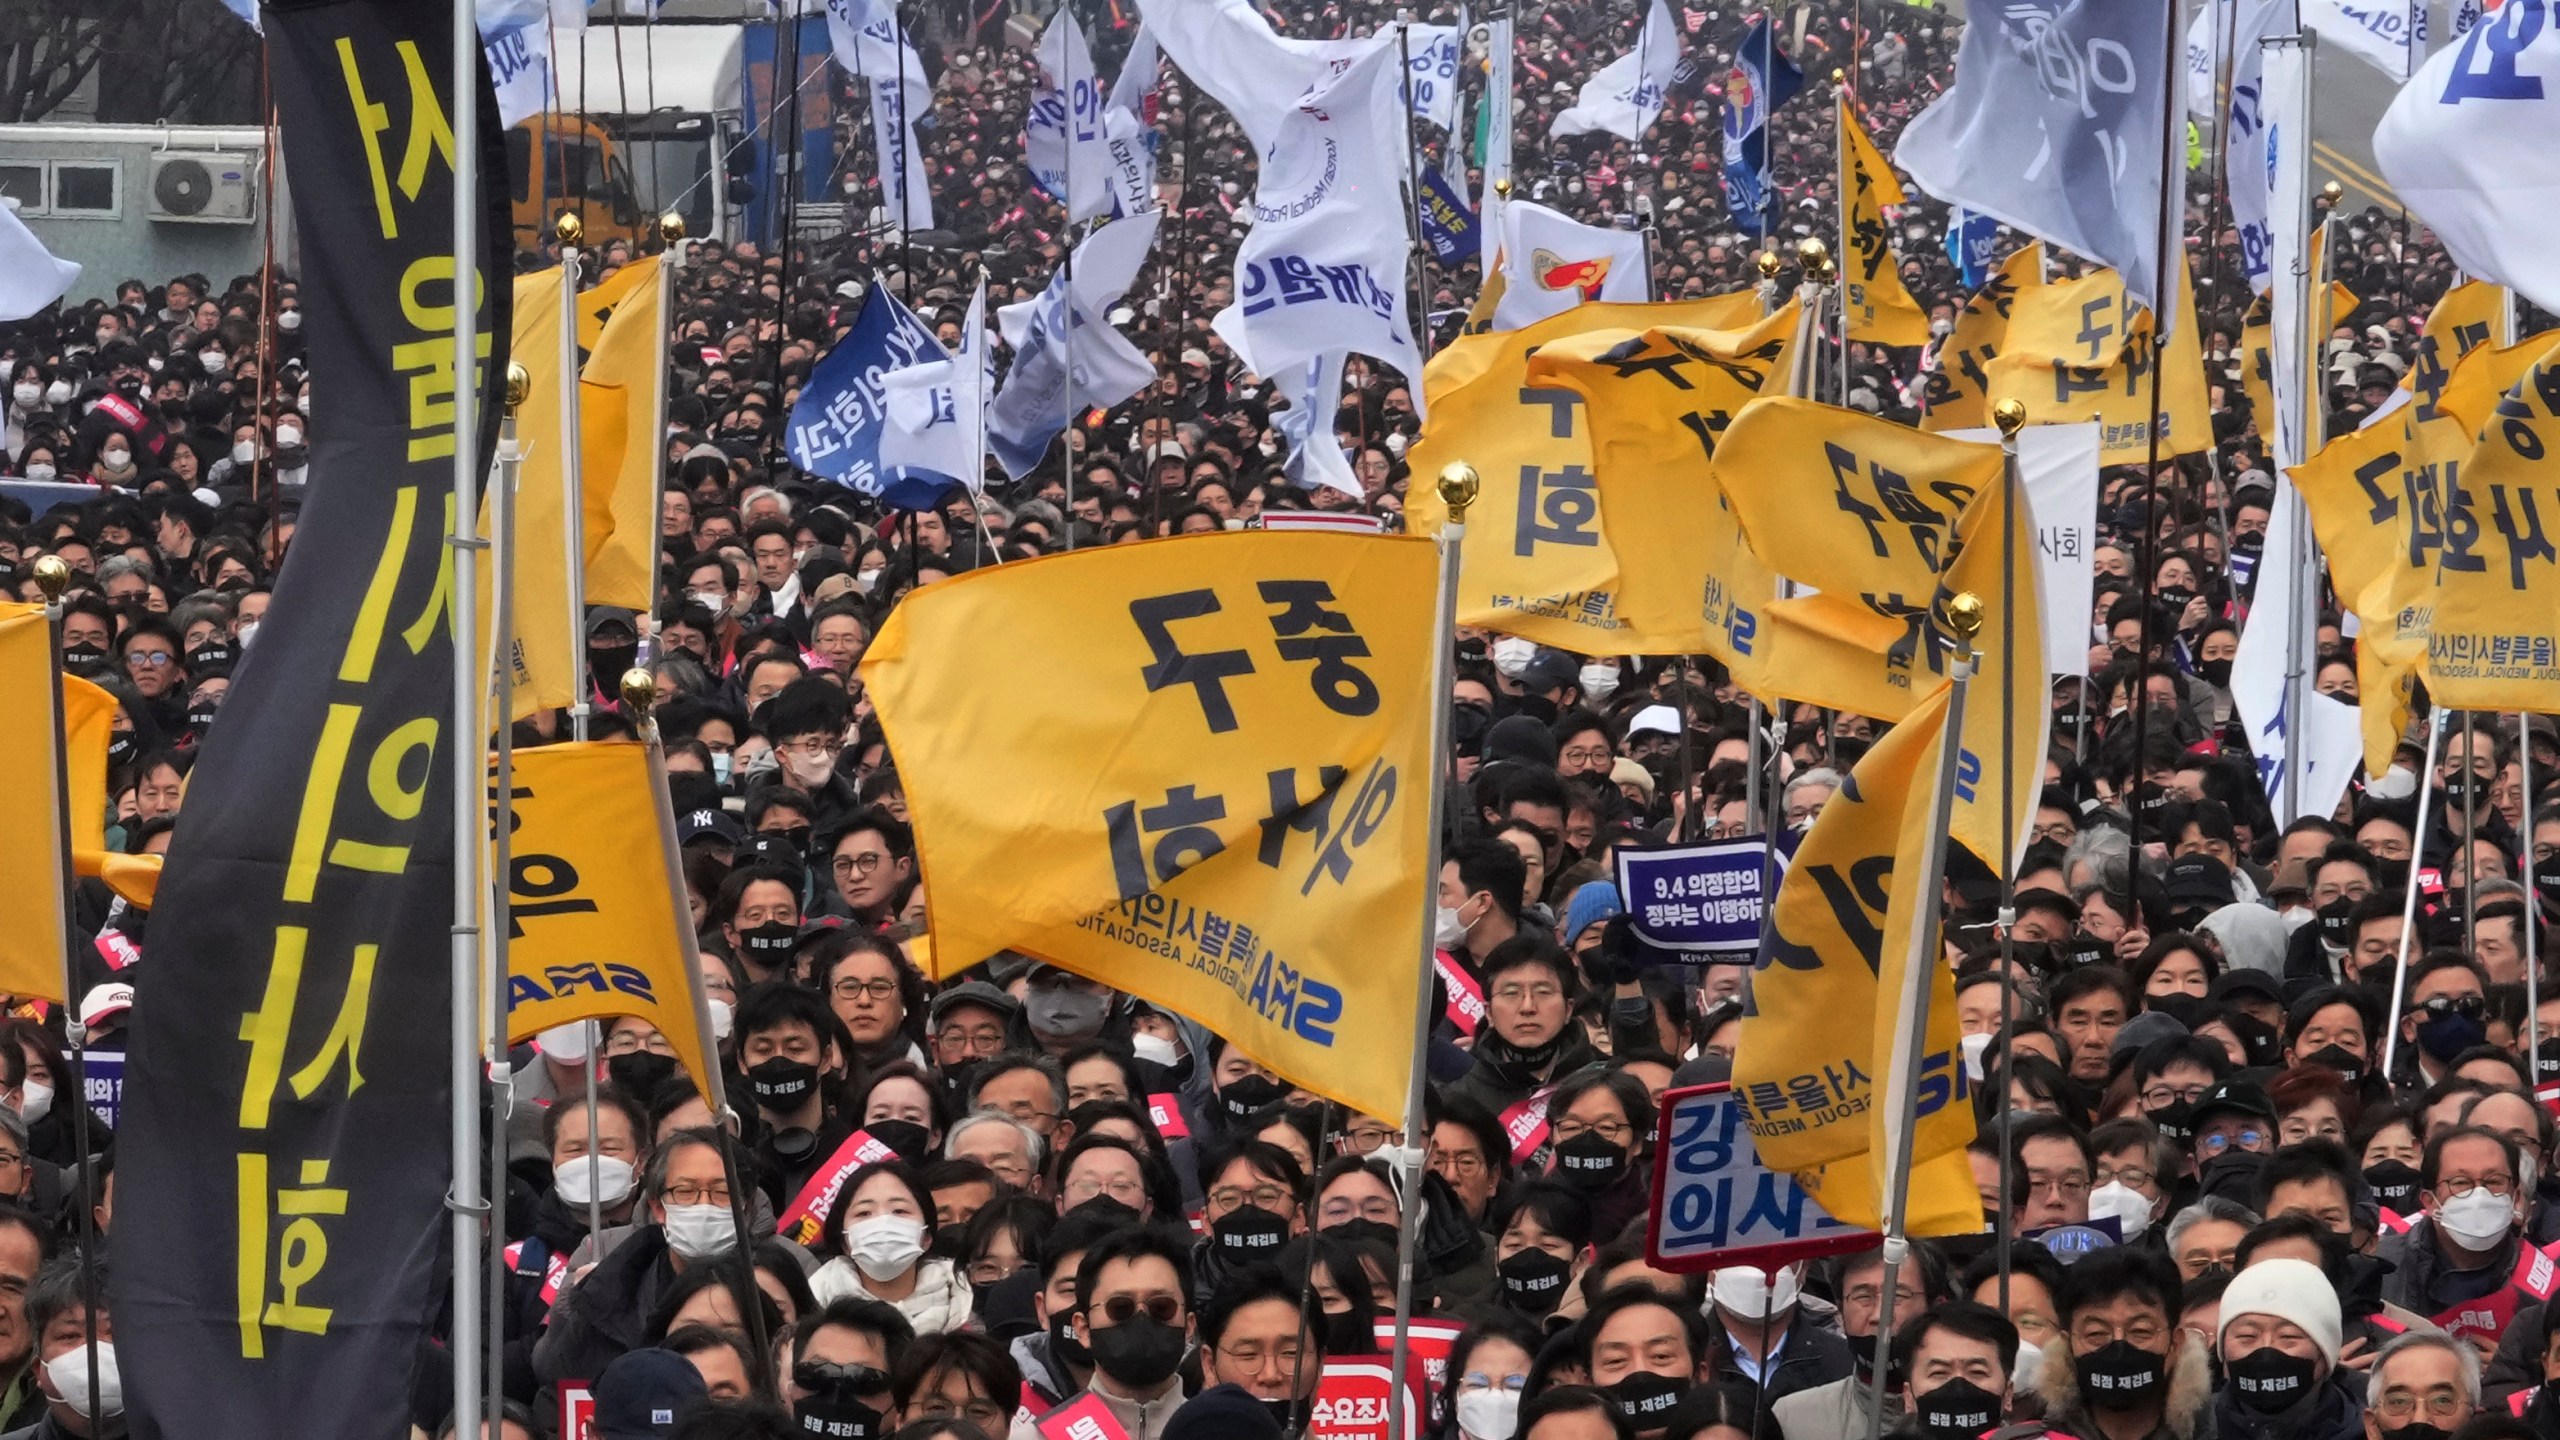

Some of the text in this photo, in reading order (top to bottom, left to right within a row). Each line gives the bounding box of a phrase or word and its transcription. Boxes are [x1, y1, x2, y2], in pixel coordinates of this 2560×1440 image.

[693, 810, 713, 827] NY
[1653, 867, 1762, 900] 9.4 의정합의
[1645, 902, 1701, 928] 정부는
[774, 1078, 806, 1095] 재검토
[1564, 1155, 1614, 1169] 원점 재검토
[1223, 1232, 1279, 1247] 원점 재검토
[1525, 1273, 1560, 1292] 재검토
[2090, 1370, 2154, 1390] 원점 재검토
[2238, 1376, 2299, 1393] 원점 재검토
[1640, 1391, 1678, 1412] 재검토
[803, 1414, 865, 1438] 원점 재검토
[1929, 1411, 1988, 1428] 원점 재검토
